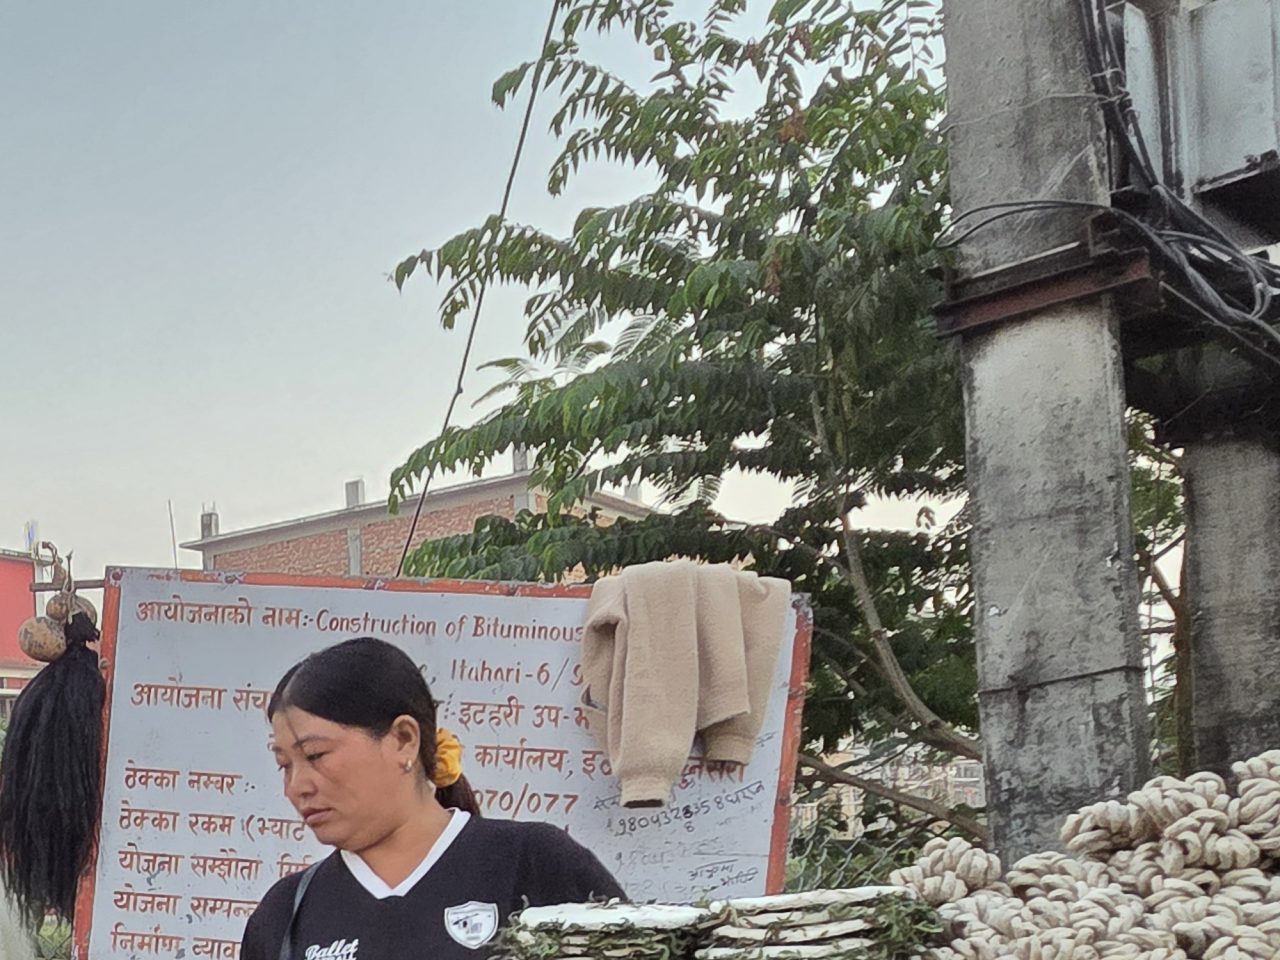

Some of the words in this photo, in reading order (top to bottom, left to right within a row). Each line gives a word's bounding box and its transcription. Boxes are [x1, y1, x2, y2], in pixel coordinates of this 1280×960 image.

[136, 595, 256, 627] आयोजनाको
[316, 609, 437, 637] Construction
[445, 615, 467, 643] of
[472, 616, 584, 643] Bituminous
[130, 673, 227, 710] आयोजना
[125, 760, 180, 790] ठेक्का
[119, 800, 180, 833] ठेक्का
[188, 813, 236, 836] रकम
[118, 842, 185, 875] योजना
[113, 883, 183, 915] योजना
